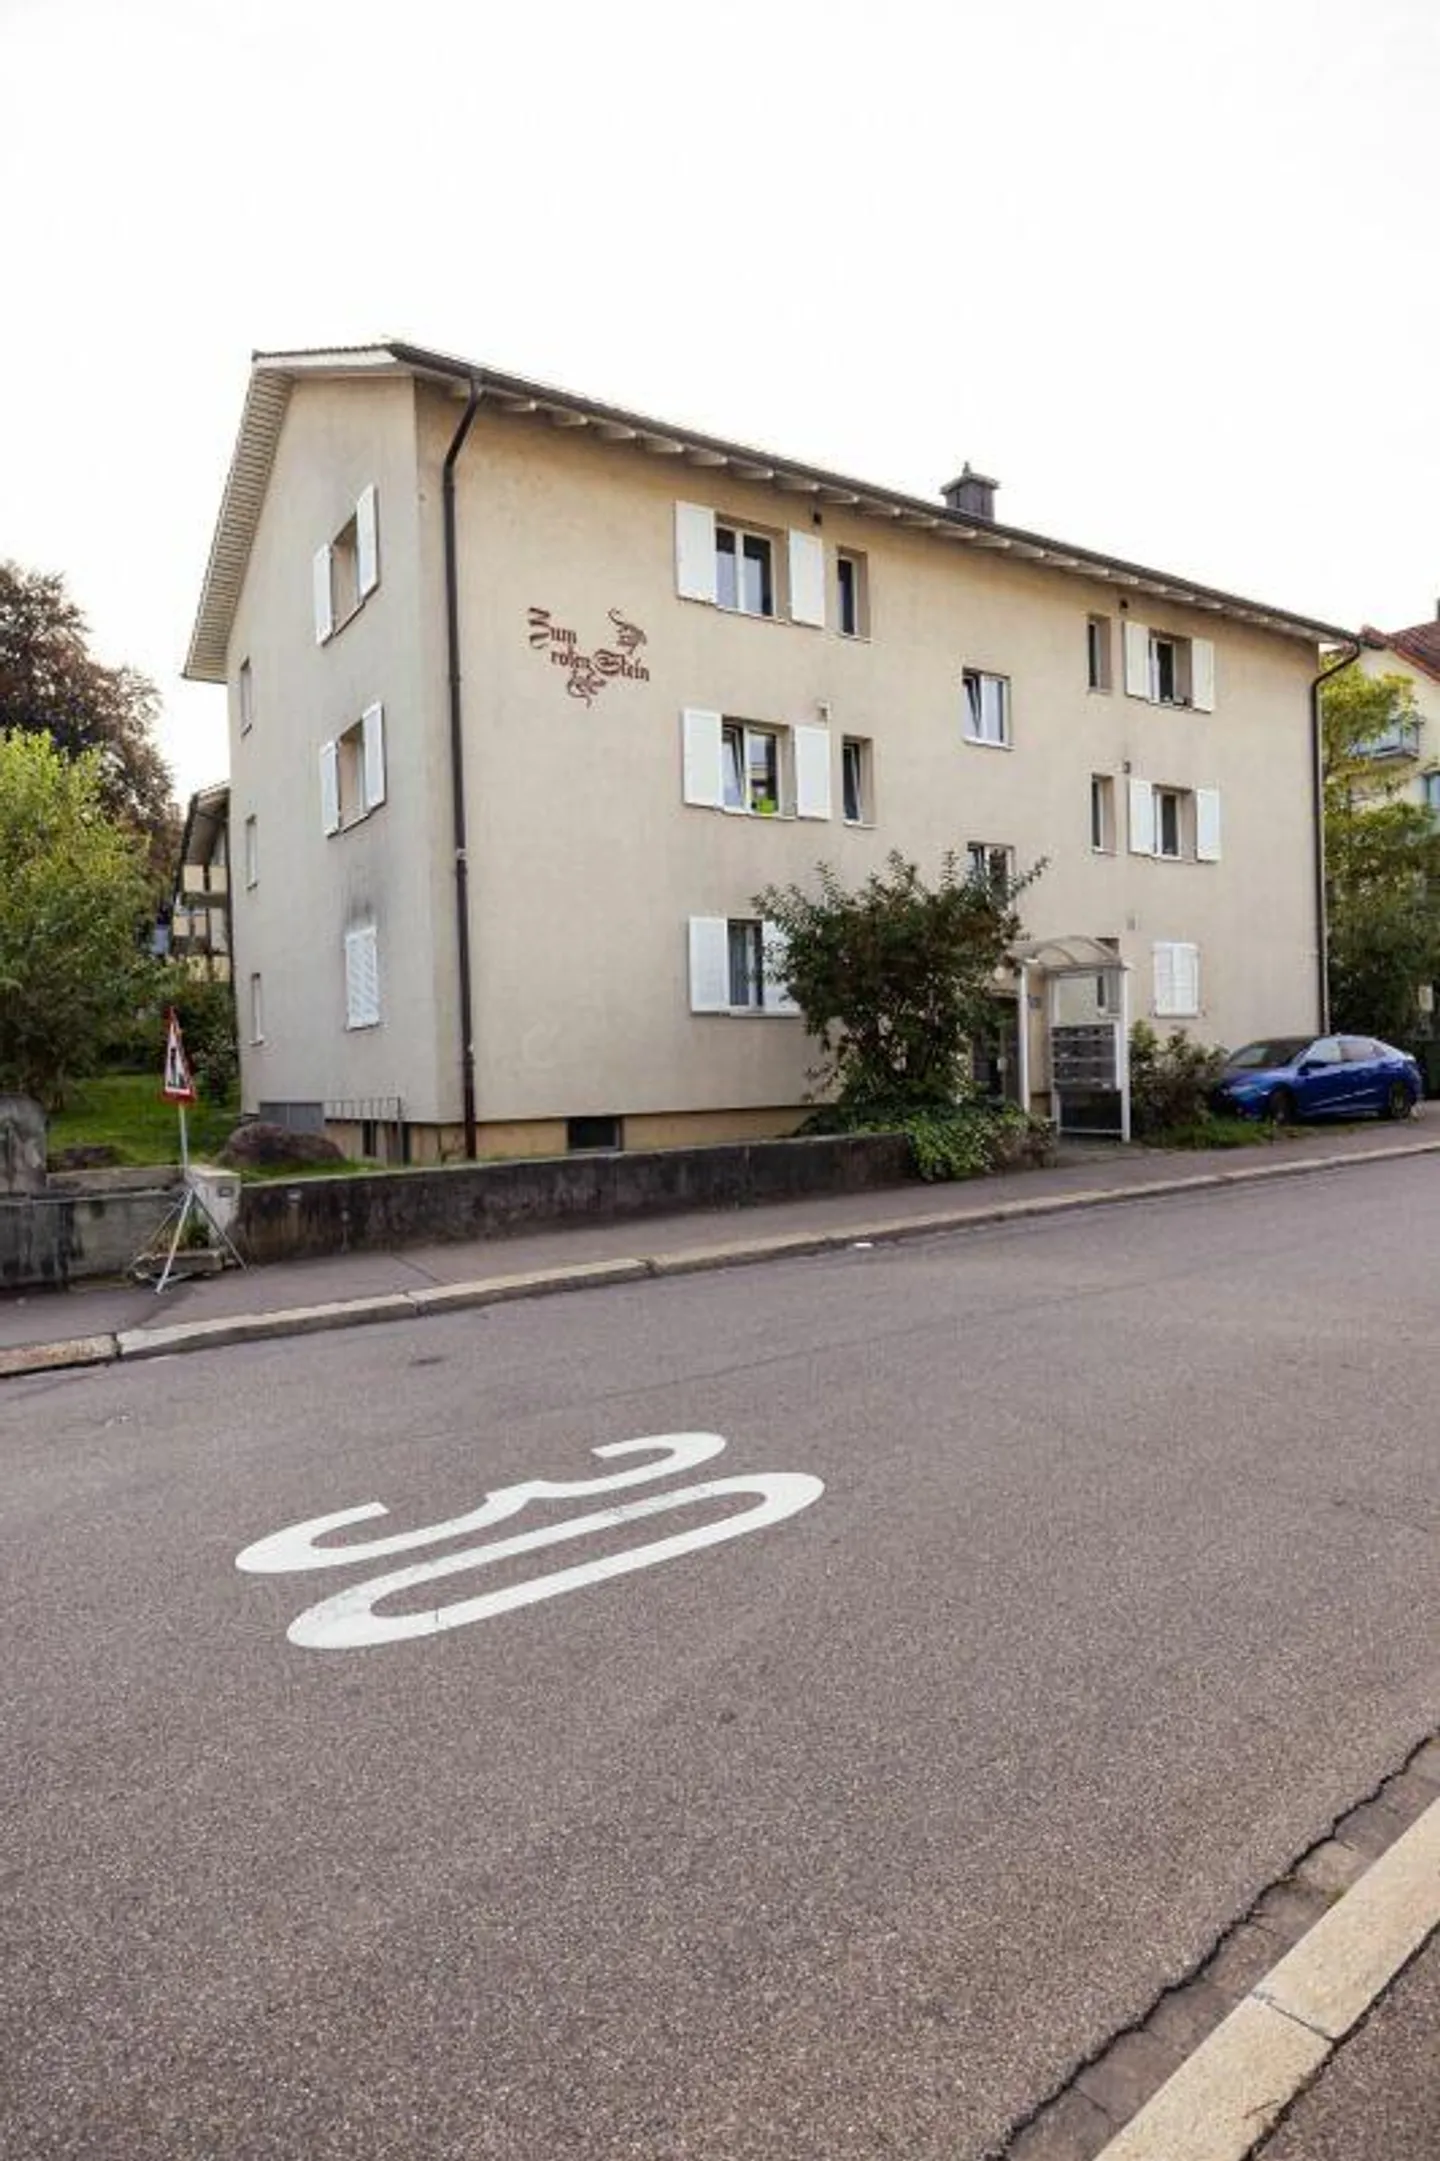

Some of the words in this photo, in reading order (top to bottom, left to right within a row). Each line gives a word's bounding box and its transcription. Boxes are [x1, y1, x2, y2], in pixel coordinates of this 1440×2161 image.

[528, 607, 577, 650] Zum
[594, 648, 650, 682] Stein
[235, 1431, 825, 1649] 30
